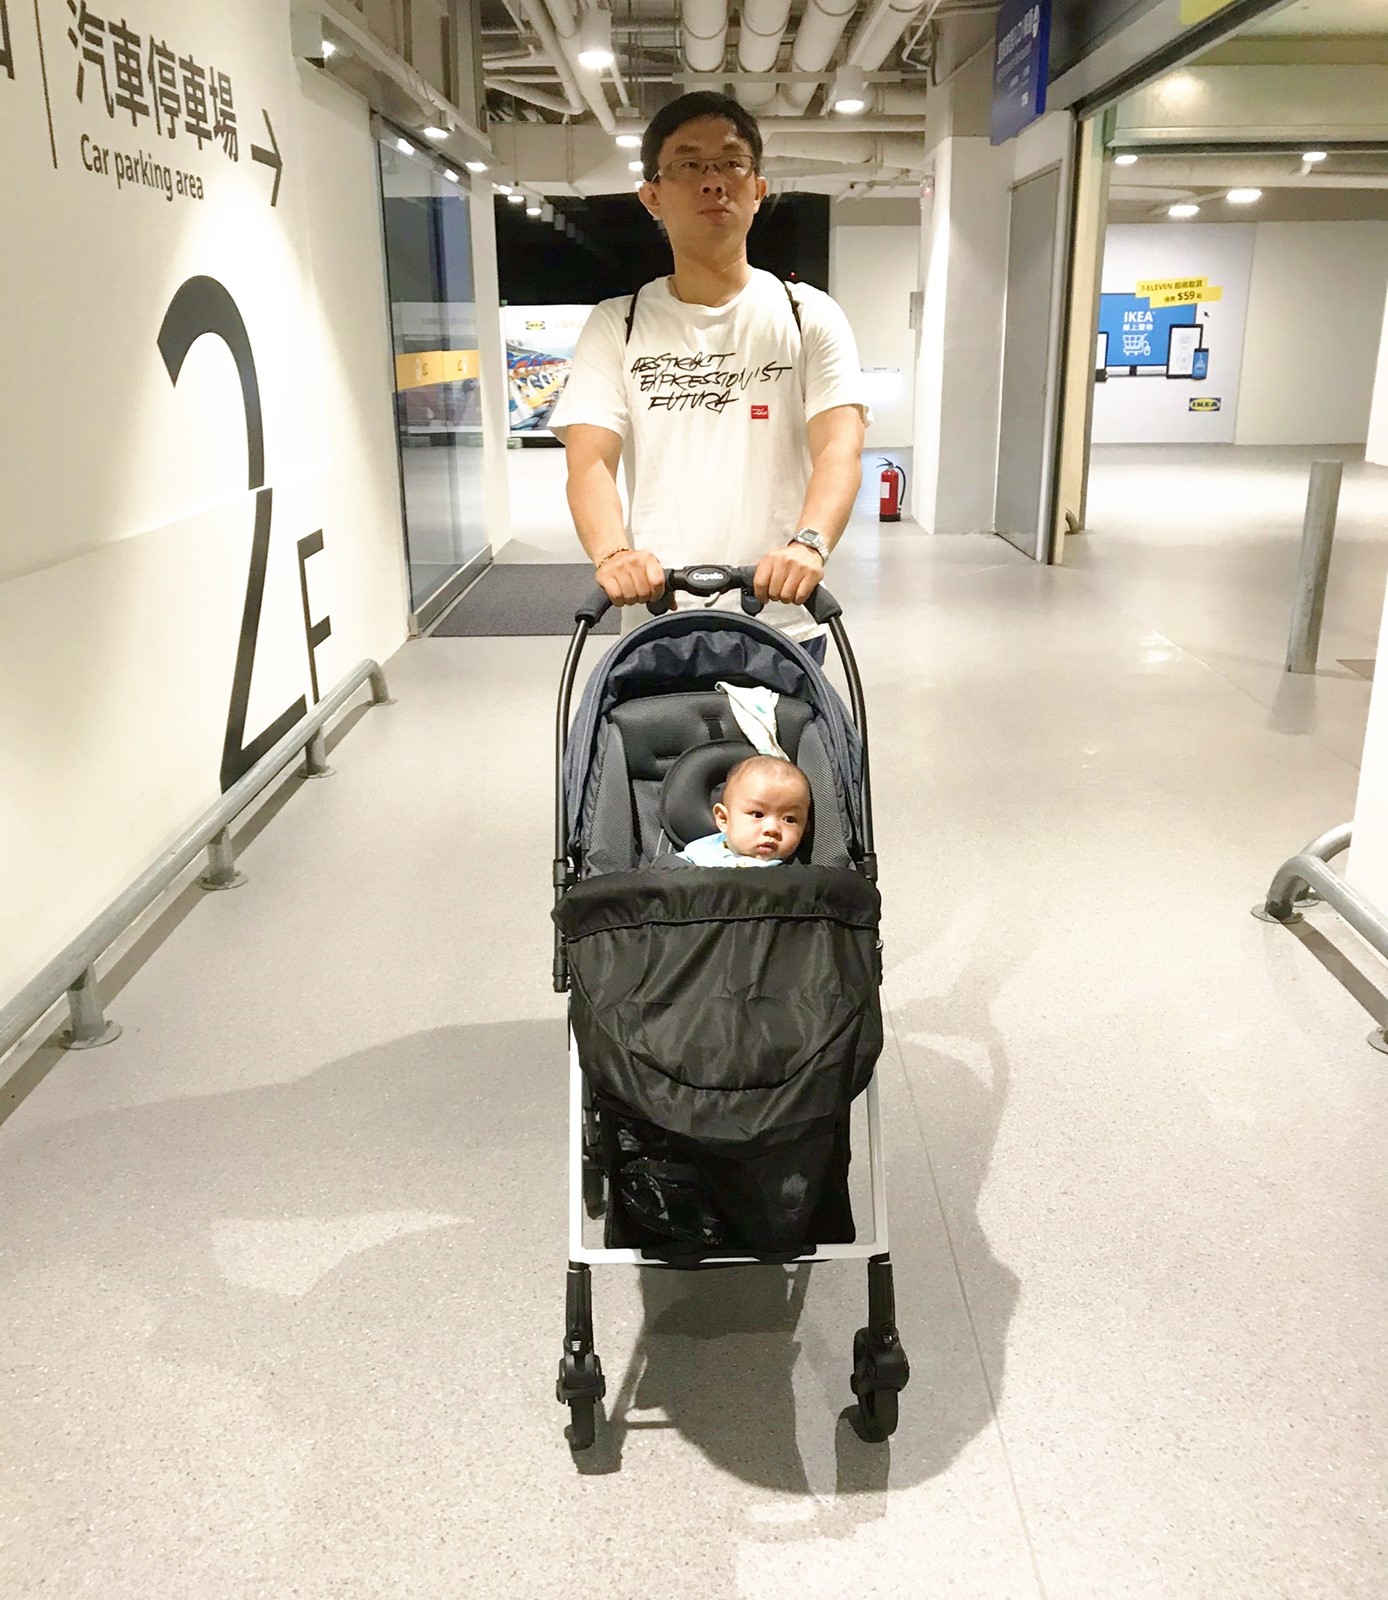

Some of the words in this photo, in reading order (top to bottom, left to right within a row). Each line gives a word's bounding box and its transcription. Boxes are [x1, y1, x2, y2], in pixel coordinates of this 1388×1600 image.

[68, 0, 239, 162] 汽車停車場
[80, 133, 110, 176] Car
[114, 149, 173, 202] parking
[176, 170, 205, 200] area
[1140, 284, 1173, 292] 7-ELEVEN
[1177, 291, 1196, 301] $59
[1124, 311, 1153, 323] IKEA
[648, 388, 739, 414] FUTURA
[1190, 400, 1219, 409] IKEA
